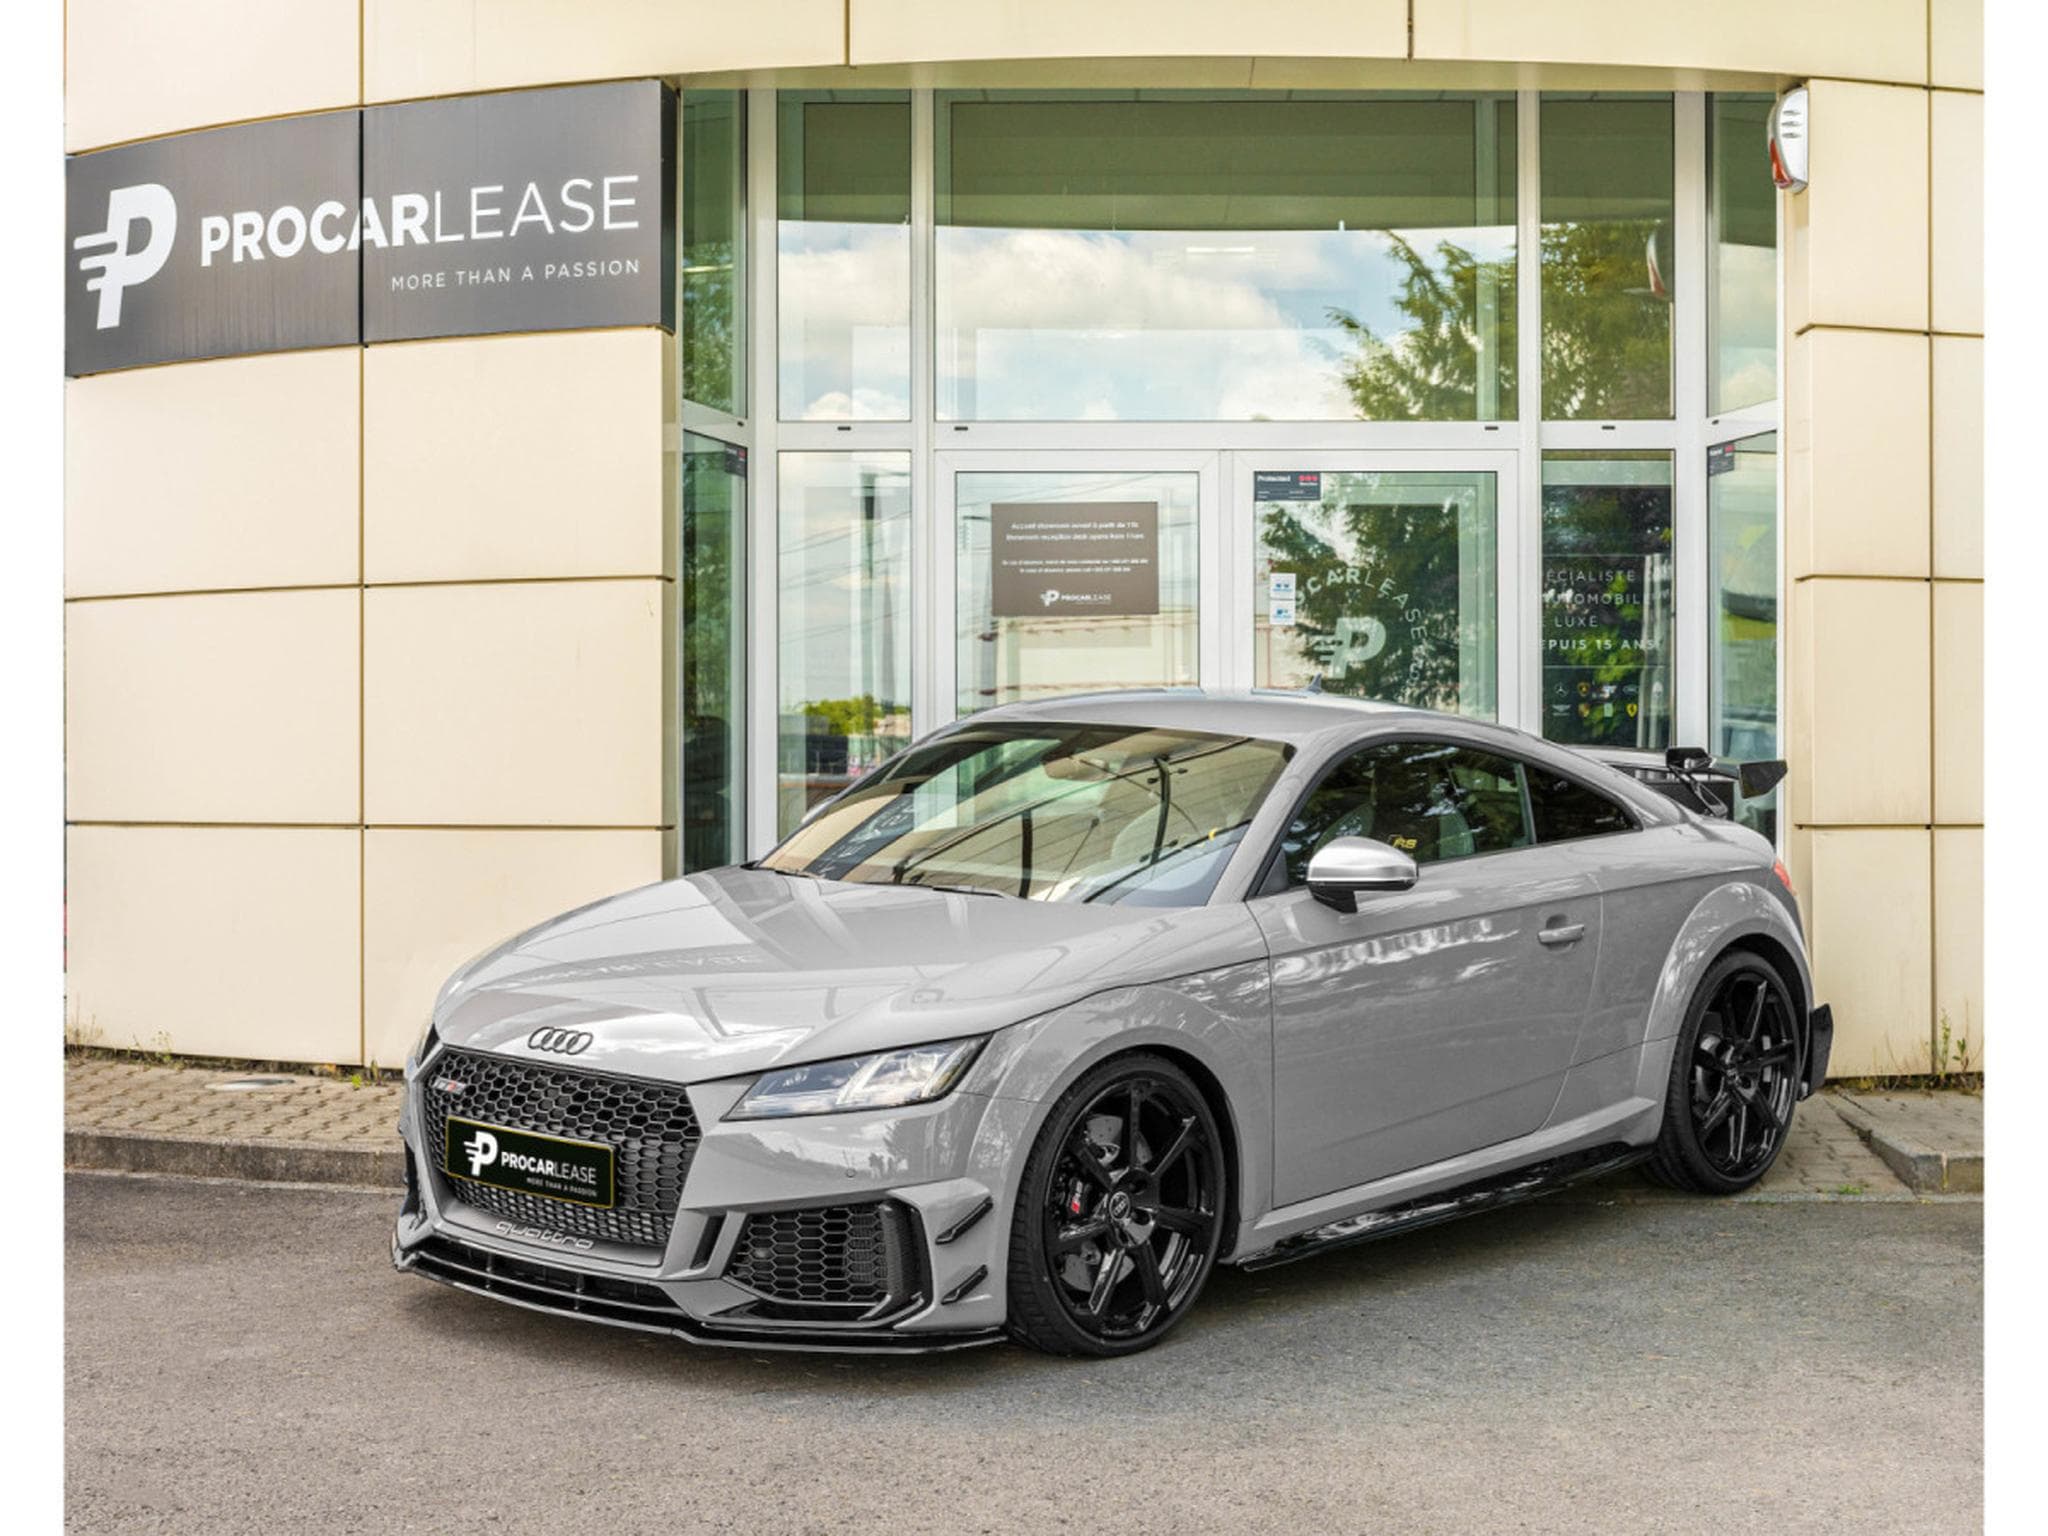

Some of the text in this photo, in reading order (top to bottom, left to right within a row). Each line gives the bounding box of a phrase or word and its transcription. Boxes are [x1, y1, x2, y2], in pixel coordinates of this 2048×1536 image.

[201, 175, 639, 267] PROCARLEASE
[391, 259, 640, 291] MORE THAN A PASSION
[1555, 615, 1598, 628] LUXE
[1596, 639, 1612, 650] 15
[501, 1151, 598, 1185] PROCARLEASE
[496, 1221, 594, 1249] quattro
